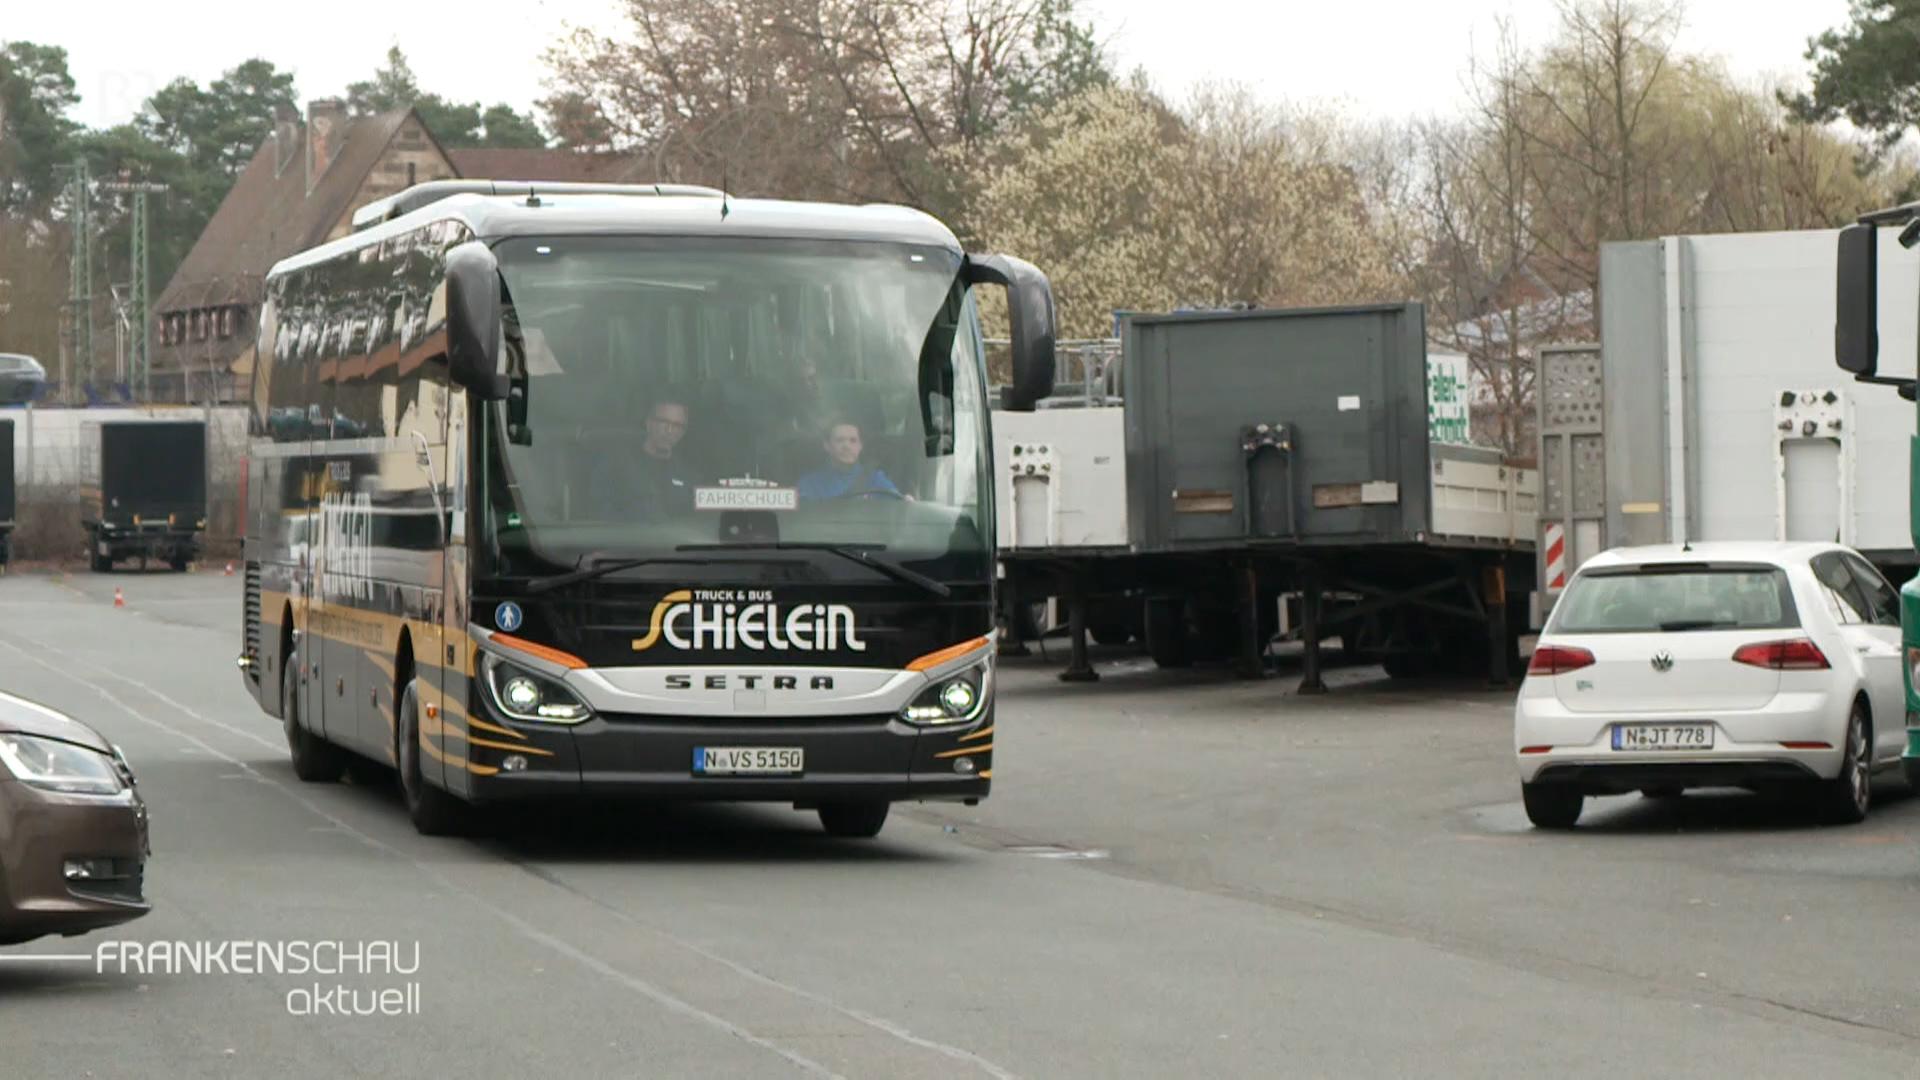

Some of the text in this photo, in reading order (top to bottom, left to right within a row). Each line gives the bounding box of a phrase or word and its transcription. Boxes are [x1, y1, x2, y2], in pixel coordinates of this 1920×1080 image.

[697, 492, 794, 506] FAHRSCHULE
[694, 590, 773, 601] TRUCK & BUS
[665, 675, 835, 690] SETRA
[1626, 728, 1705, 744] N JT 778
[704, 750, 802, 769] N VS 5150
